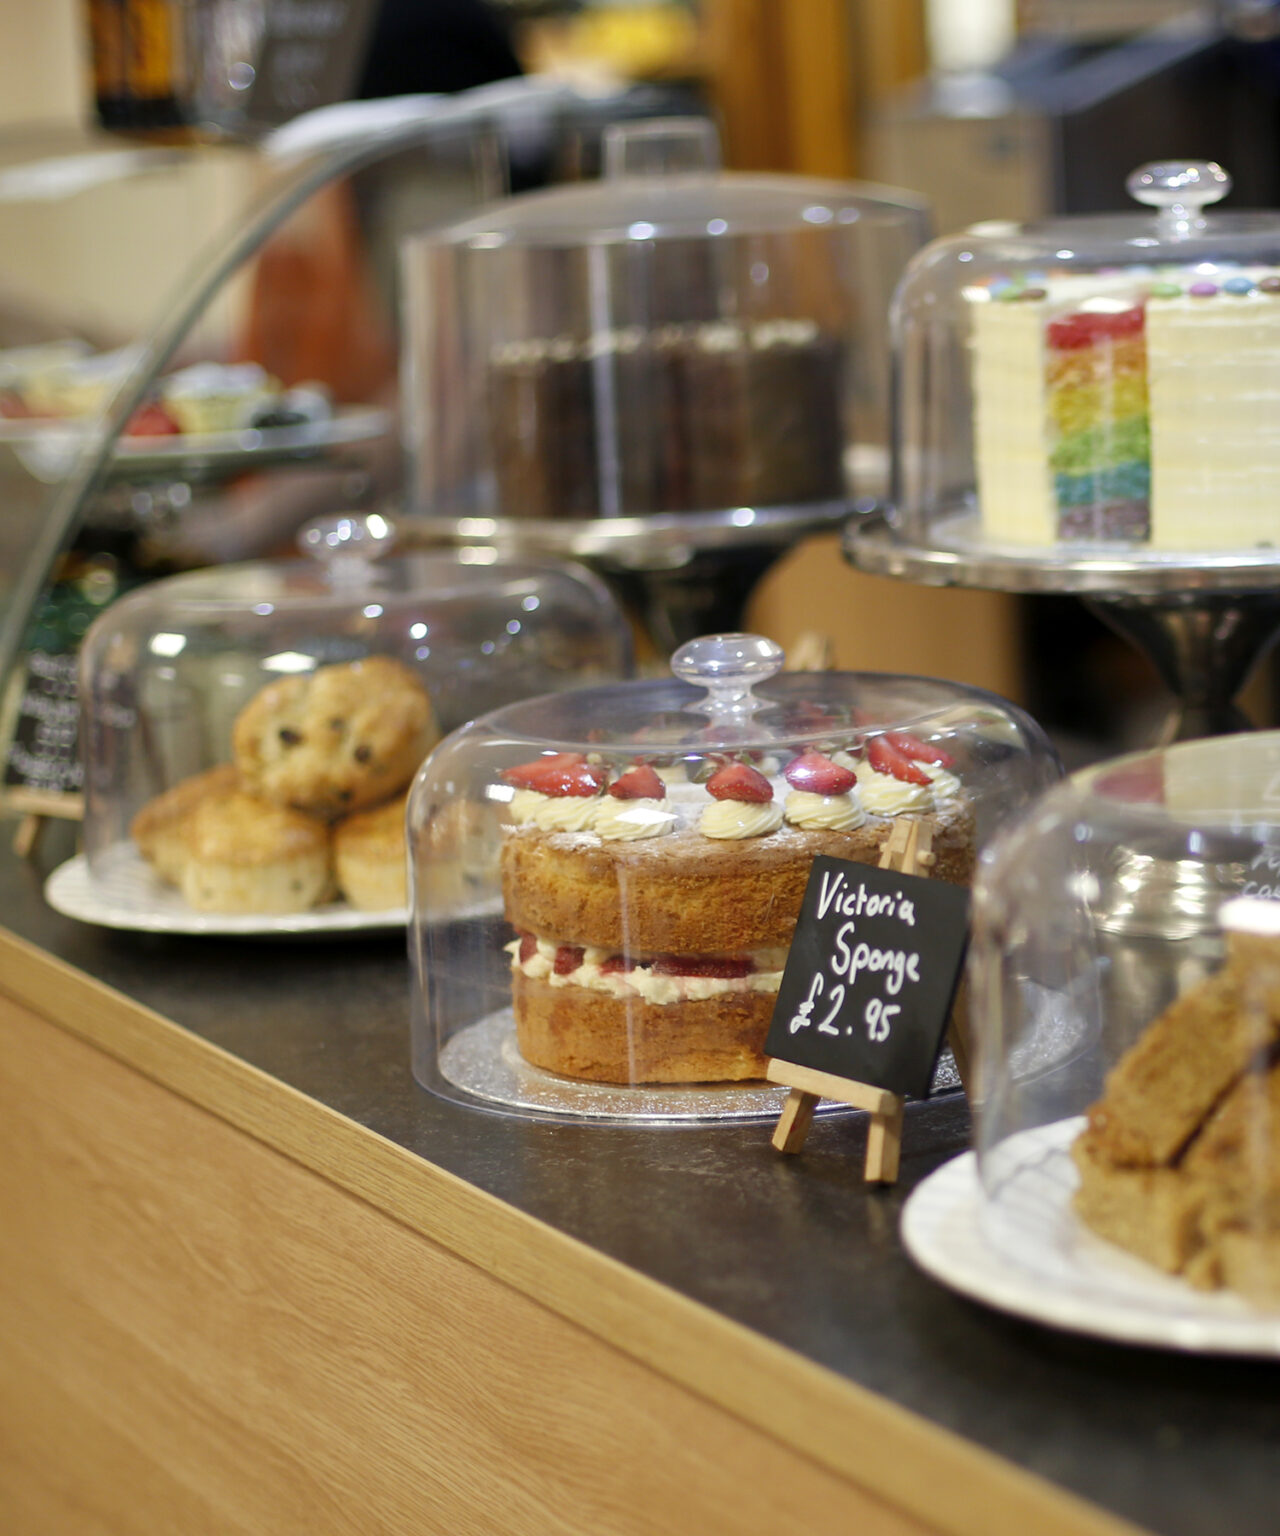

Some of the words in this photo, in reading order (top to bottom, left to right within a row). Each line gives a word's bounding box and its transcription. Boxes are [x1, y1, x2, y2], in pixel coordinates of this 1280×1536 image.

[817, 870, 916, 927] Victoria
[831, 920, 921, 996] Sponge
[789, 971, 902, 1043] £2.95
